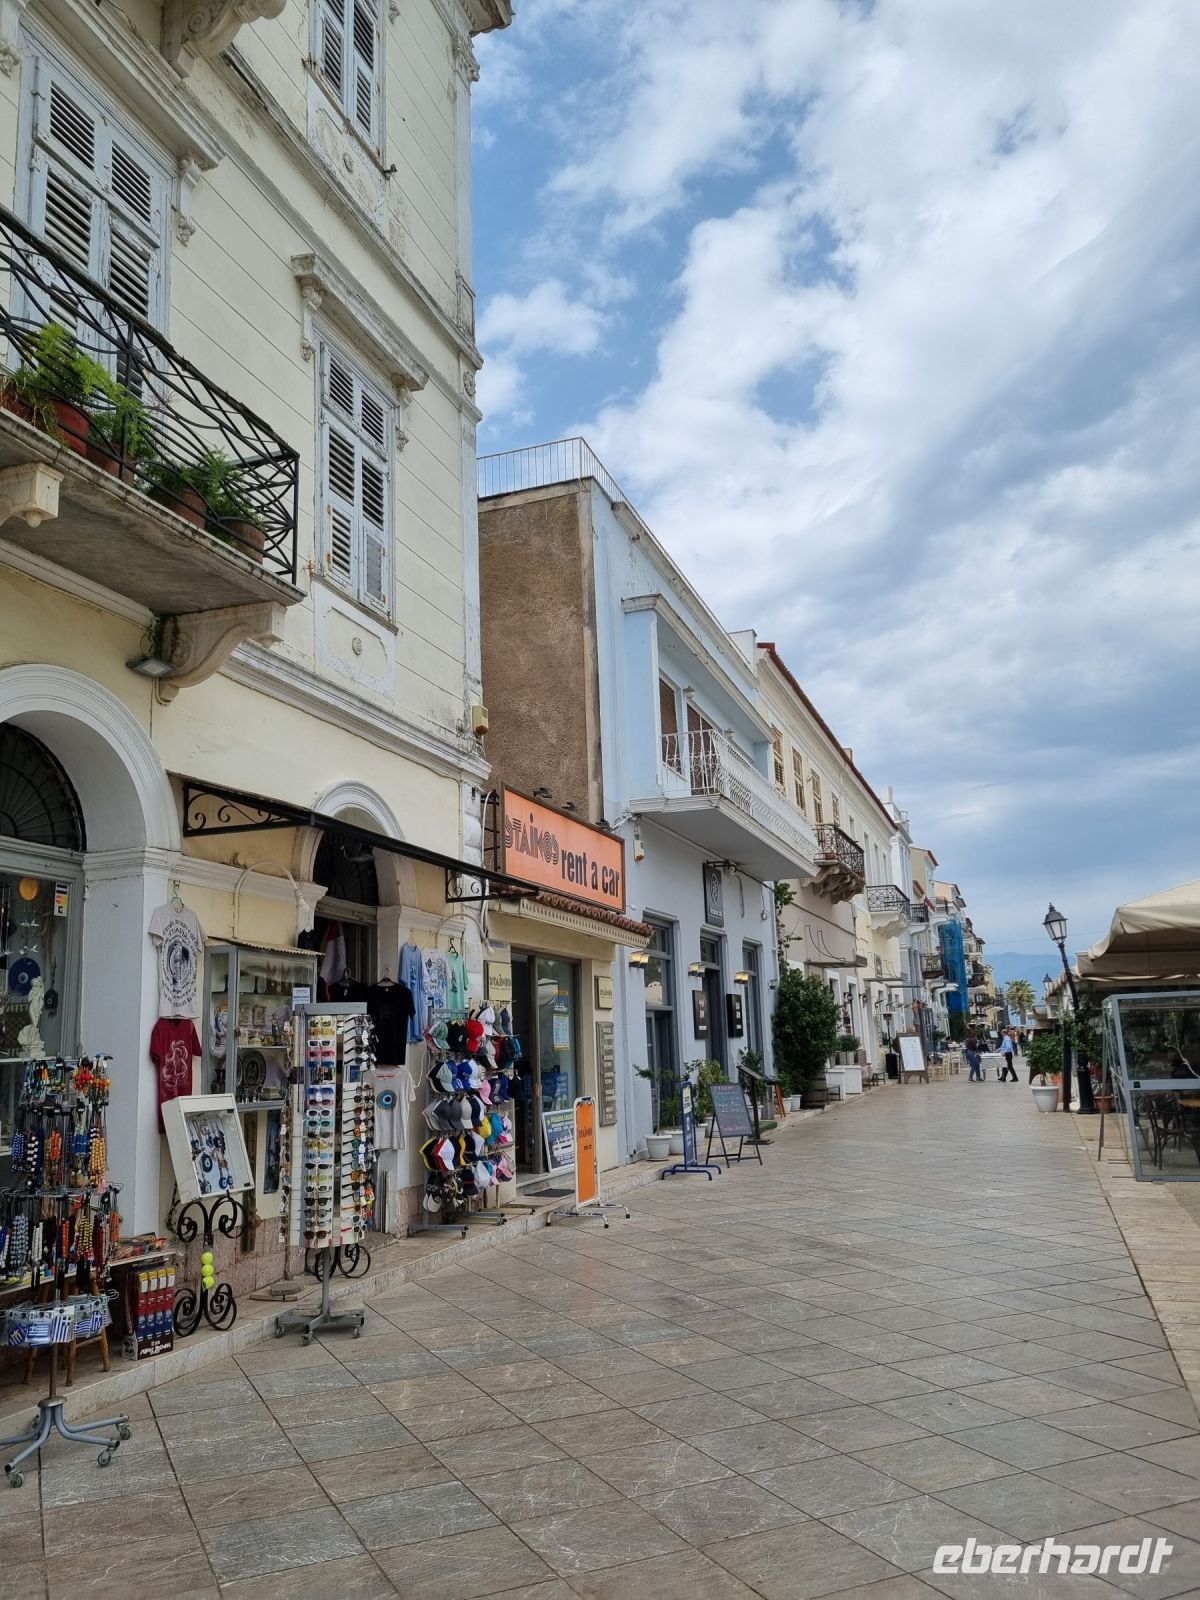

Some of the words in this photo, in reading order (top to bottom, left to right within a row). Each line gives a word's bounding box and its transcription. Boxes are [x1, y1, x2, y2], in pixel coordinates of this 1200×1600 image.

[561, 849, 587, 887] rent
[591, 861, 598, 890] a
[601, 865, 620, 897] car
